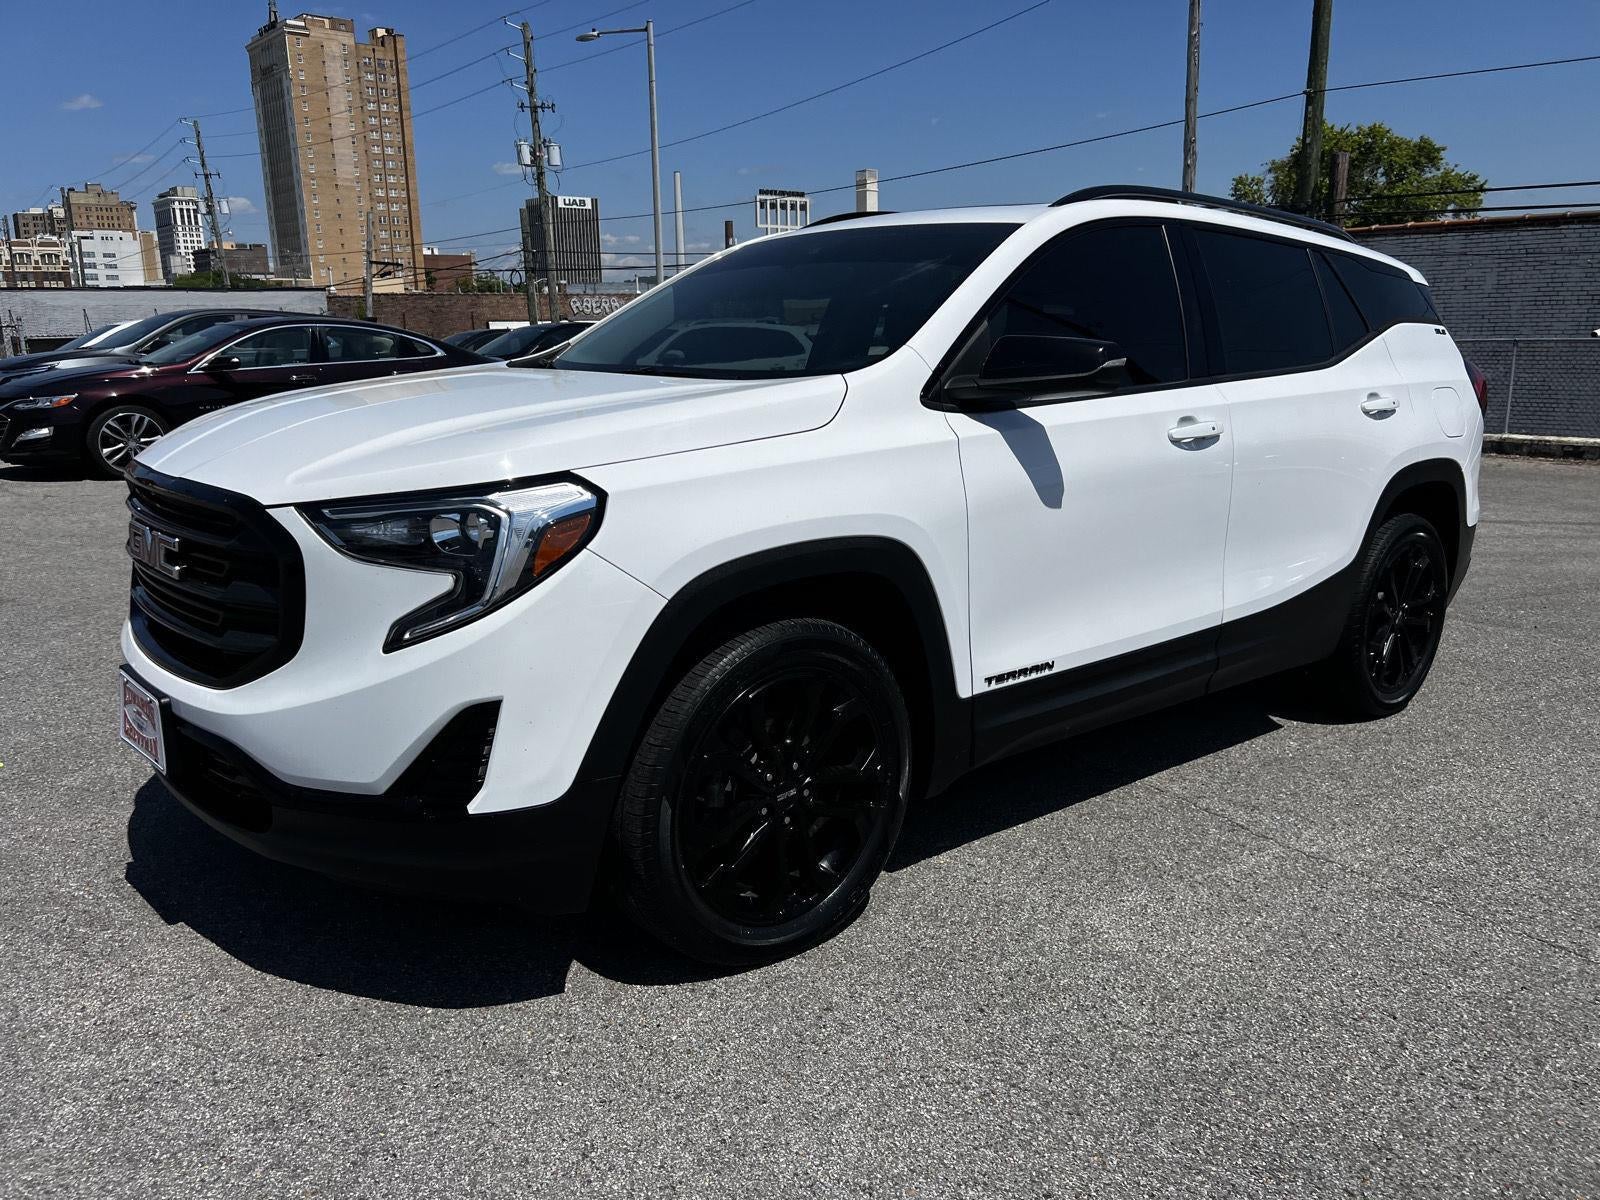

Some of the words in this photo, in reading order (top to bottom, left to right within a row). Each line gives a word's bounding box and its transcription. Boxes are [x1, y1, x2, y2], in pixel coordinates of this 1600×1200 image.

[563, 198, 587, 207] UAB
[127, 520, 180, 580] GMC
[984, 660, 1055, 687] TERRAIN
